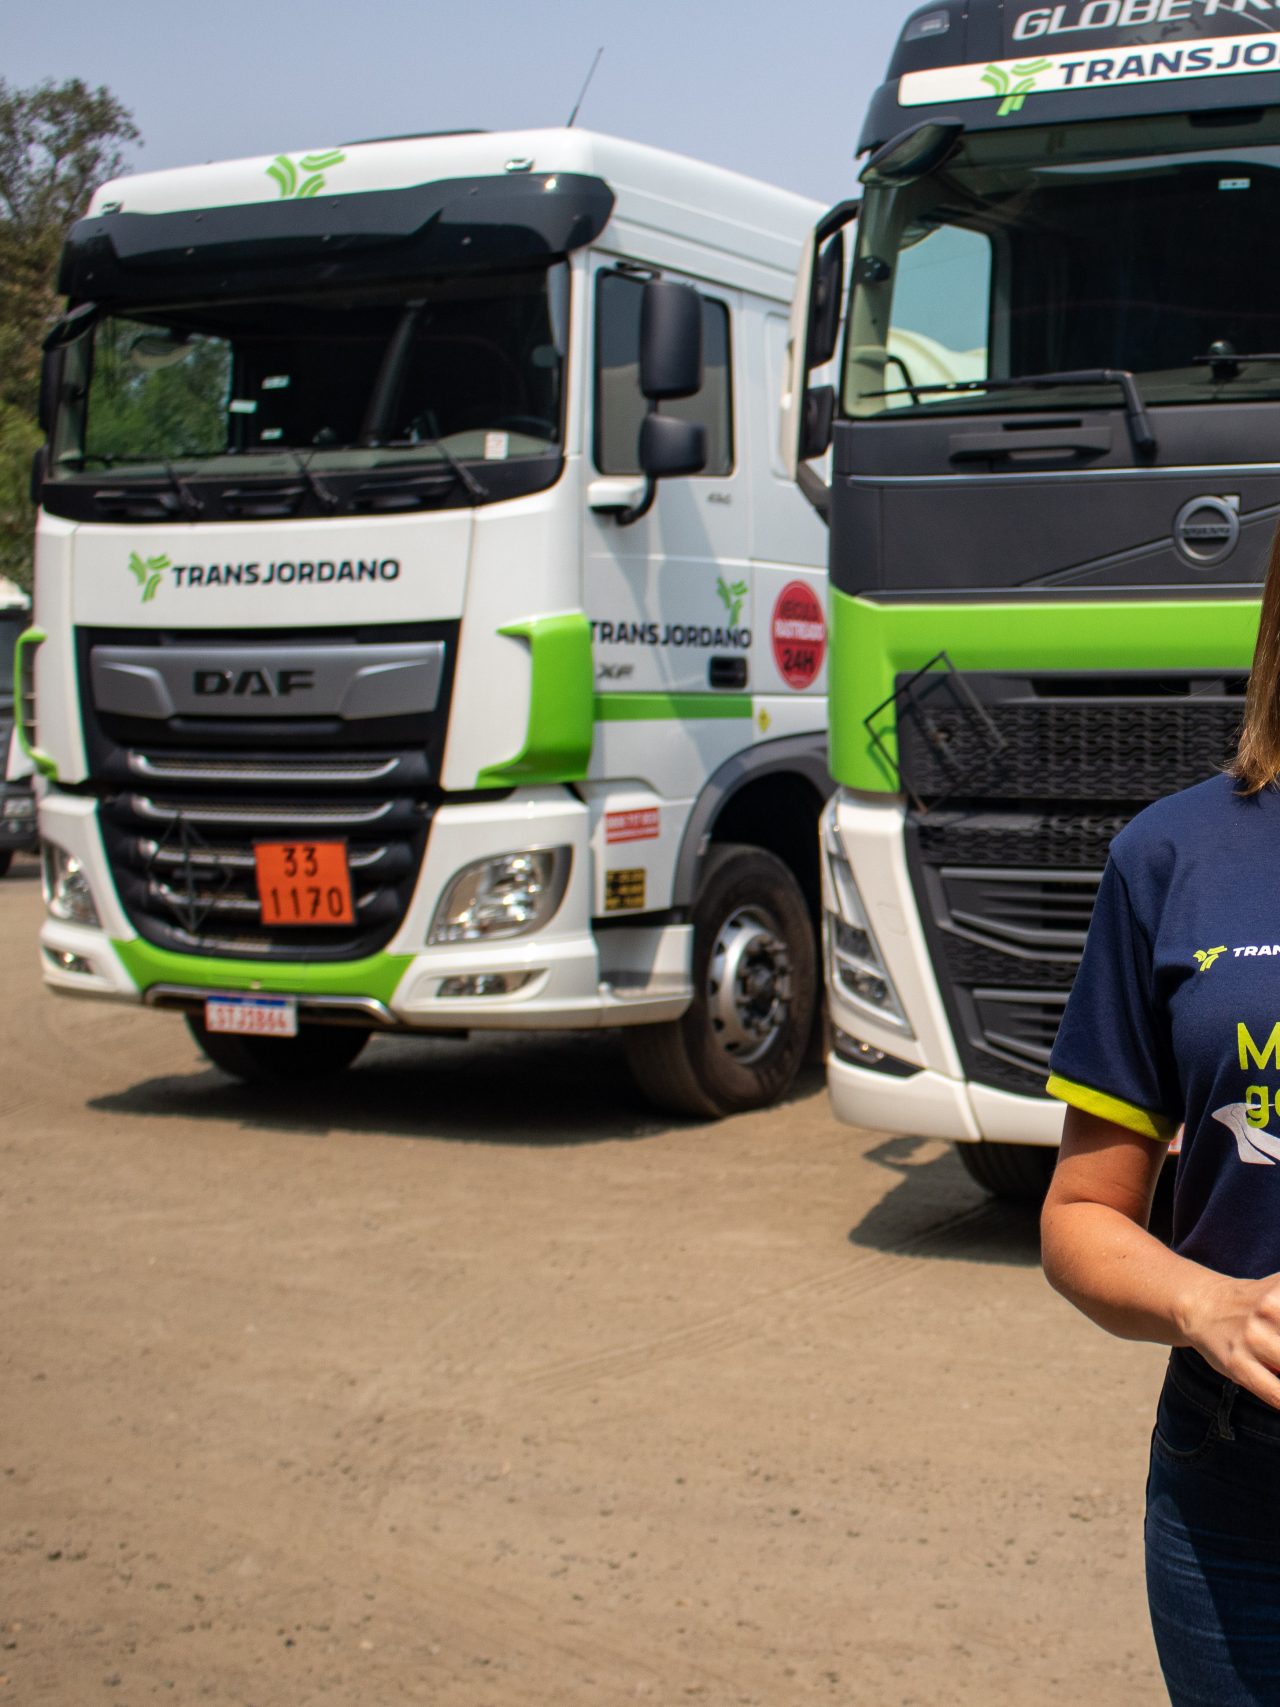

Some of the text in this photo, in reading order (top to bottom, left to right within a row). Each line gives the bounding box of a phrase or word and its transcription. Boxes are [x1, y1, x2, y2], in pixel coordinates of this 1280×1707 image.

[172, 560, 400, 588] TRANSJORDANO
[590, 620, 752, 649] TRANSJORDANO
[783, 648, 817, 673] 24H
[192, 669, 315, 696] DAF
[282, 846, 319, 878] 33
[271, 886, 344, 918] 1170
